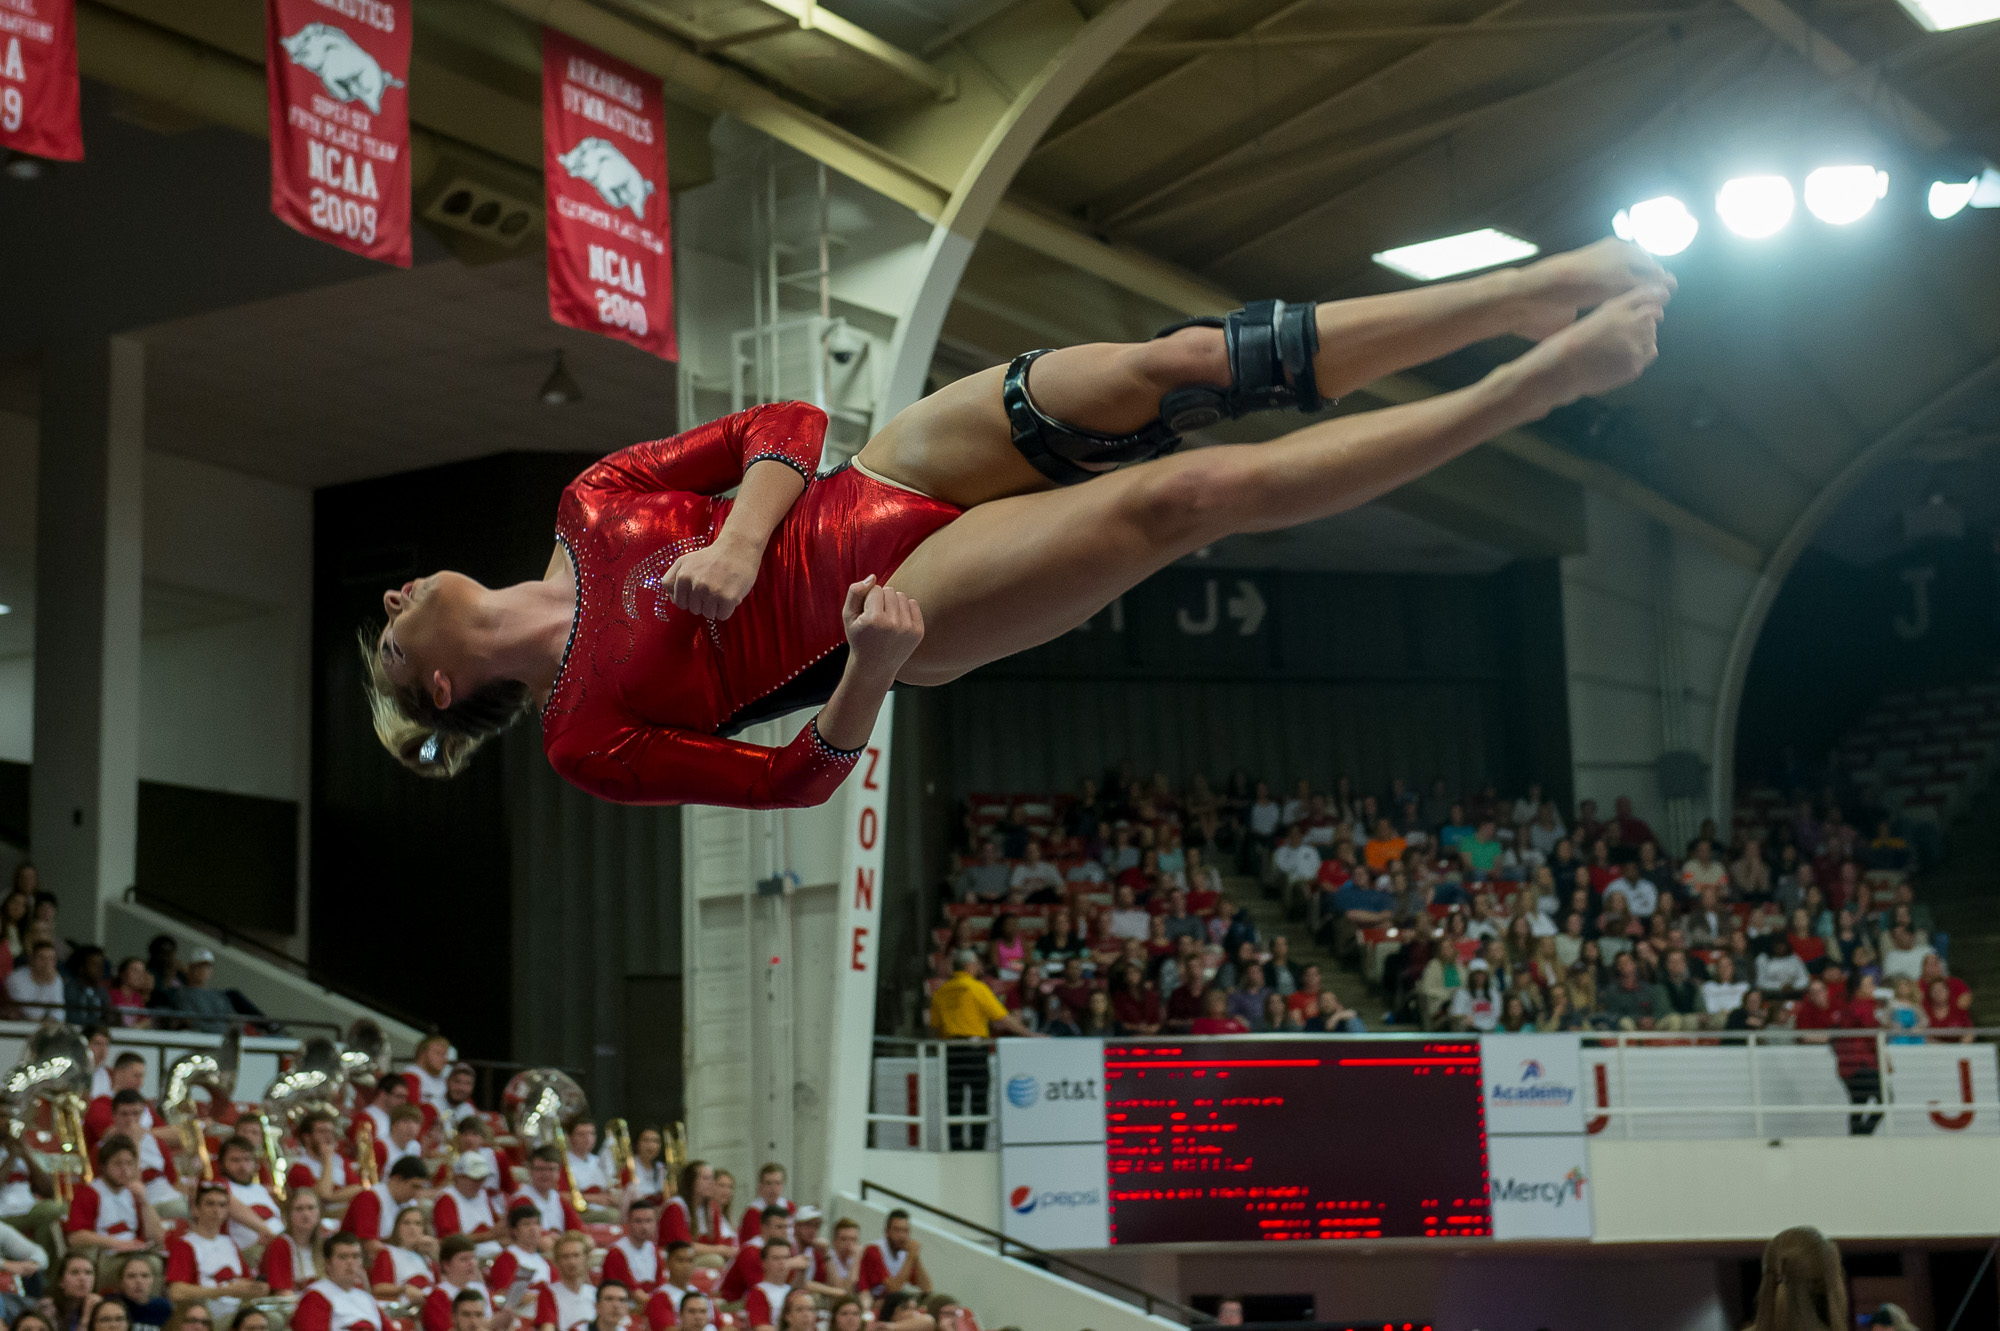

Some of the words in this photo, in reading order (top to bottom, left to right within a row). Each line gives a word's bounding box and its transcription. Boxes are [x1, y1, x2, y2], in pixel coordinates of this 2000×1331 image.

[0, 86, 23, 132] 9
[307, 138, 379, 201] NCAA
[309, 186, 378, 245] 2009
[588, 242, 647, 298] NCAA
[1178, 579, 1218, 635] J
[851, 747, 881, 971] ZONE
[1491, 1084, 1576, 1107] Academy
[1928, 1058, 1975, 1131] J
[1040, 1187, 1100, 1209] pepsi
[1491, 1177, 1568, 1209] Mercy
